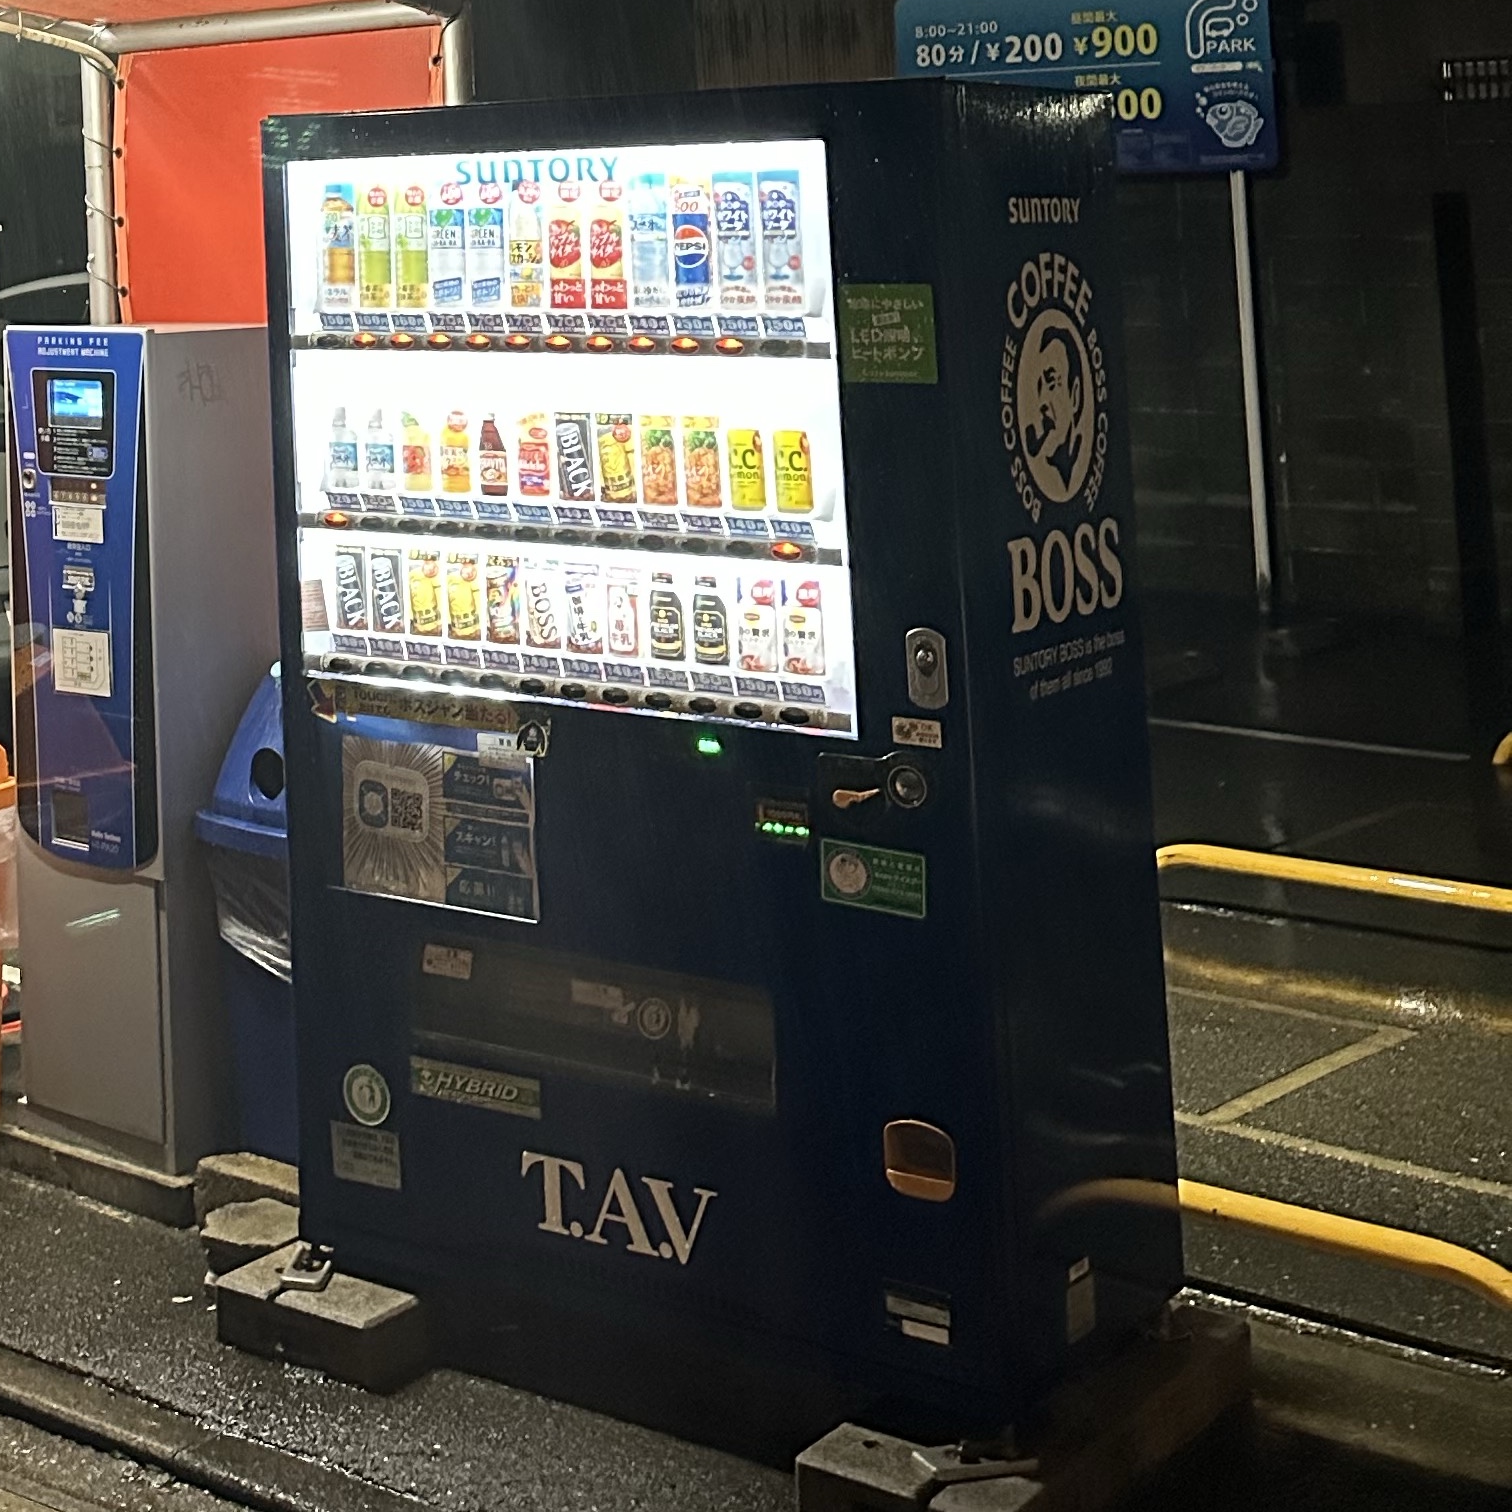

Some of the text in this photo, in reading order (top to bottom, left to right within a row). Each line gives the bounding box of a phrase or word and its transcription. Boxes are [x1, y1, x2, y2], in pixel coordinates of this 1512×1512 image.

[1206, 37, 1256, 53] PARK
[455, 156, 619, 185] SUNTORY
[1009, 196, 1081, 224] SUNTORY
[1007, 251, 1093, 329] COFFEE
[1000, 334, 1043, 524] BOSS COFFEE
[1085, 327, 1108, 513] BOSS COFFEE
[560, 433, 593, 497] BLACK
[373, 568, 403, 629] BLACK
[1007, 517, 1123, 634] BOSS
[531, 582, 558, 640] BOSS
[435, 1071, 519, 1103] HYBRID
